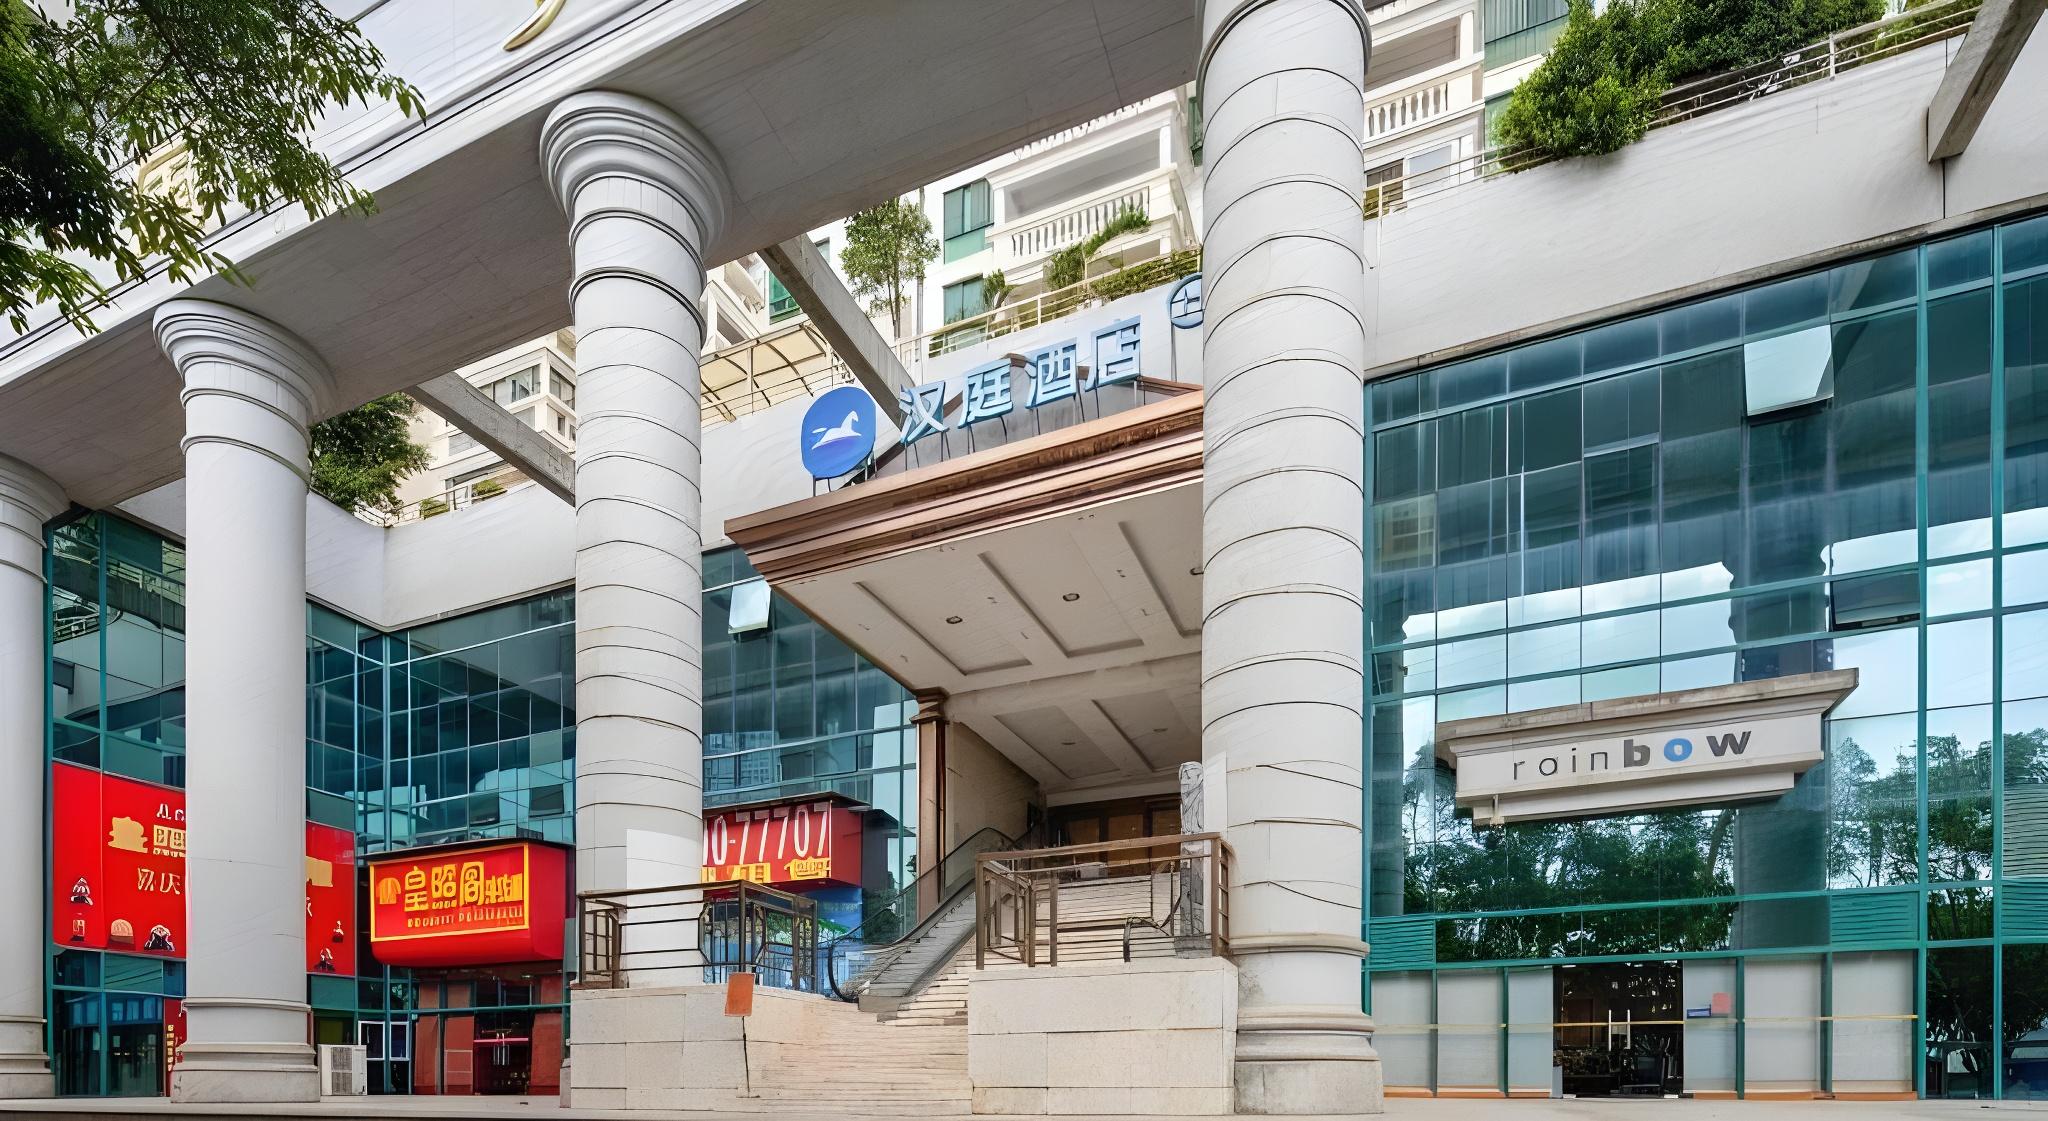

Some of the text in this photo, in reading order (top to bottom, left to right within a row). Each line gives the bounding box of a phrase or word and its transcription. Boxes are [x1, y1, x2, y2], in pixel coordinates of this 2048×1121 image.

[899, 314, 1142, 446] 汉庭酒店
[1513, 730, 1752, 781] rainbow
